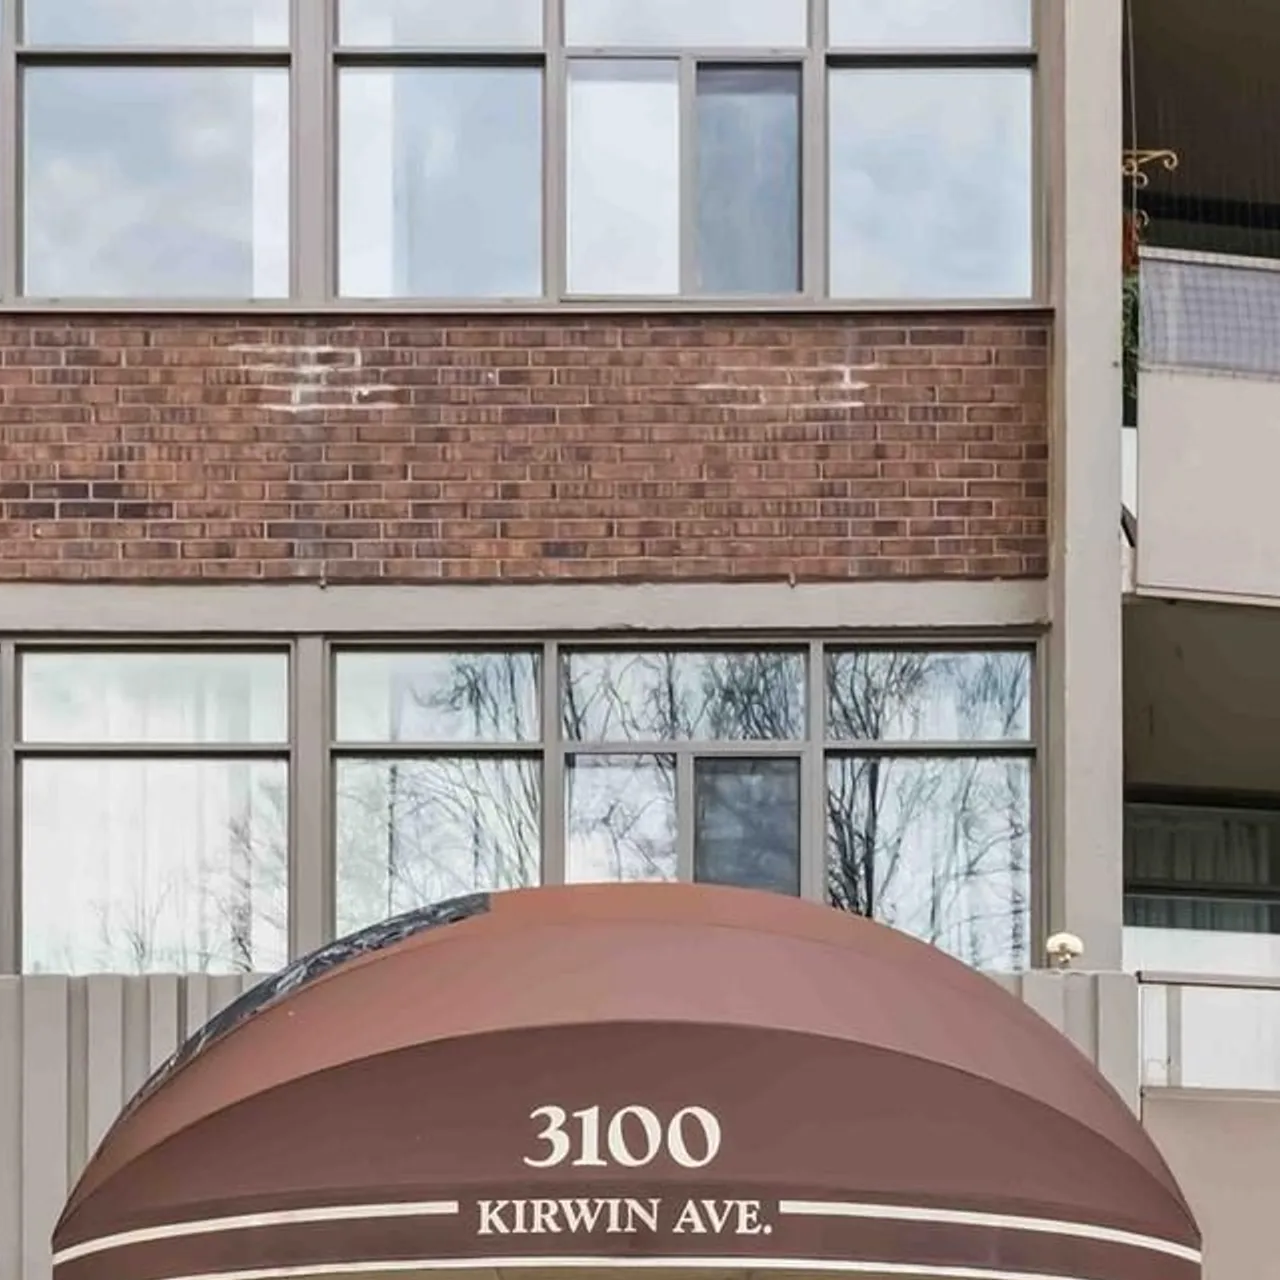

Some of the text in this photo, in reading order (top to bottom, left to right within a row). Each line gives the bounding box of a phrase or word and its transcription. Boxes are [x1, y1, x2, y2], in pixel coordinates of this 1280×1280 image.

[523, 1104, 721, 1168] 3100
[476, 1198, 773, 1235] KIRWIN AVE.
